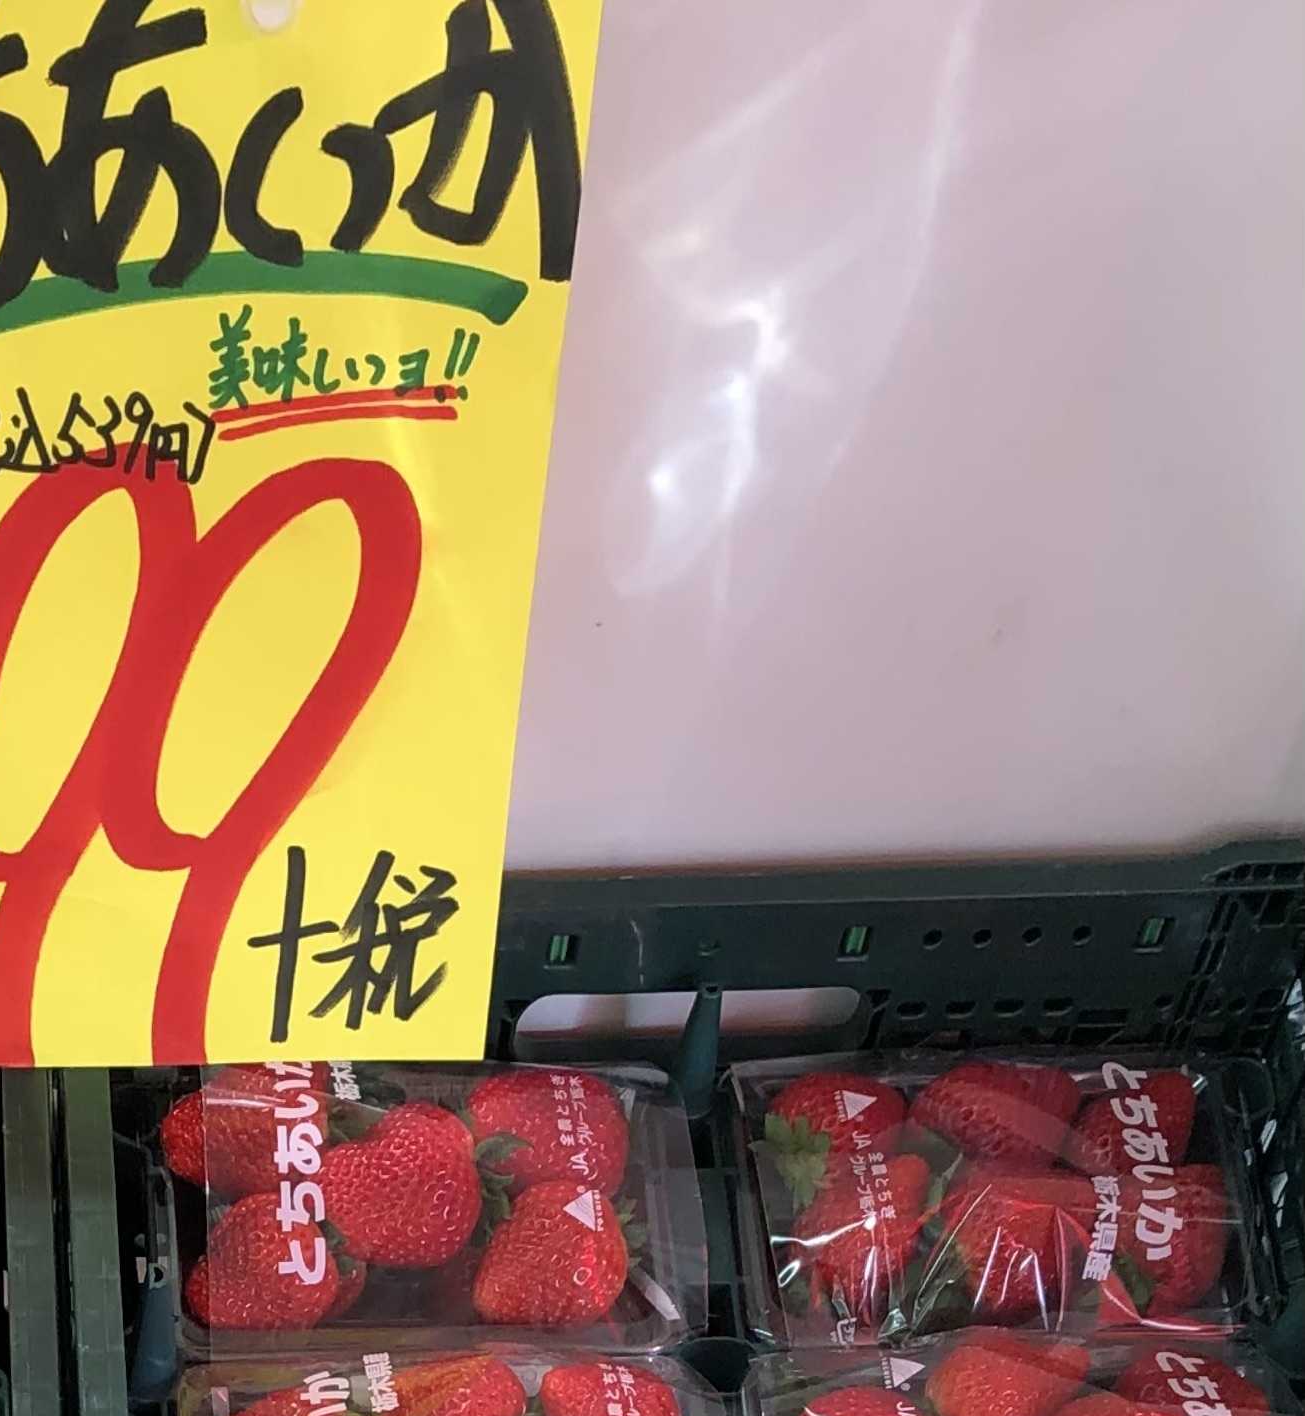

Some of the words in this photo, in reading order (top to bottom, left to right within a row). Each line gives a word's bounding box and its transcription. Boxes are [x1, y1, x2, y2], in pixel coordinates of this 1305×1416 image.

[570, 1148, 591, 1175] JA
[852, 1130, 872, 1150] JA
[1102, 1060, 1185, 1262] とちあいか
[1081, 1175, 1123, 1282] 栃木県産
